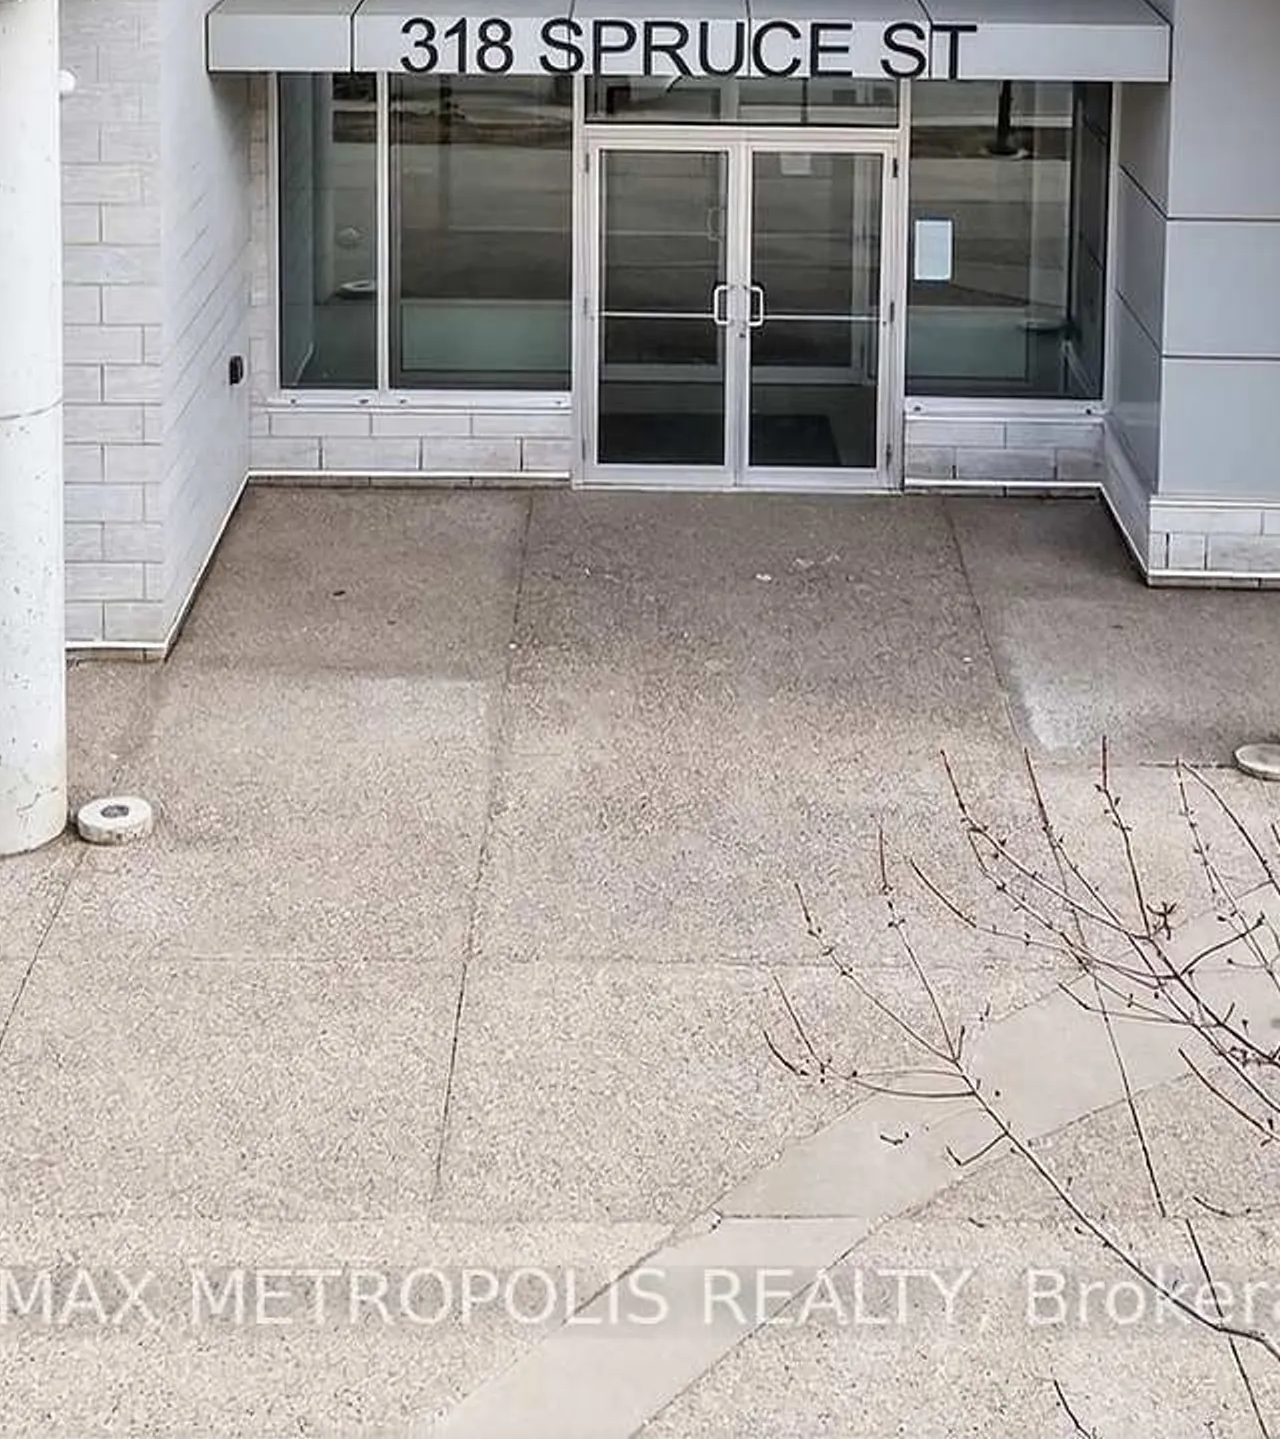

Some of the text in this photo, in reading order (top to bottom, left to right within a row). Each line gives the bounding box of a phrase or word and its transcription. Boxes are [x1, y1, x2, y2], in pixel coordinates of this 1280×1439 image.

[399, 17, 979, 81] 318 SPRUCE ST
